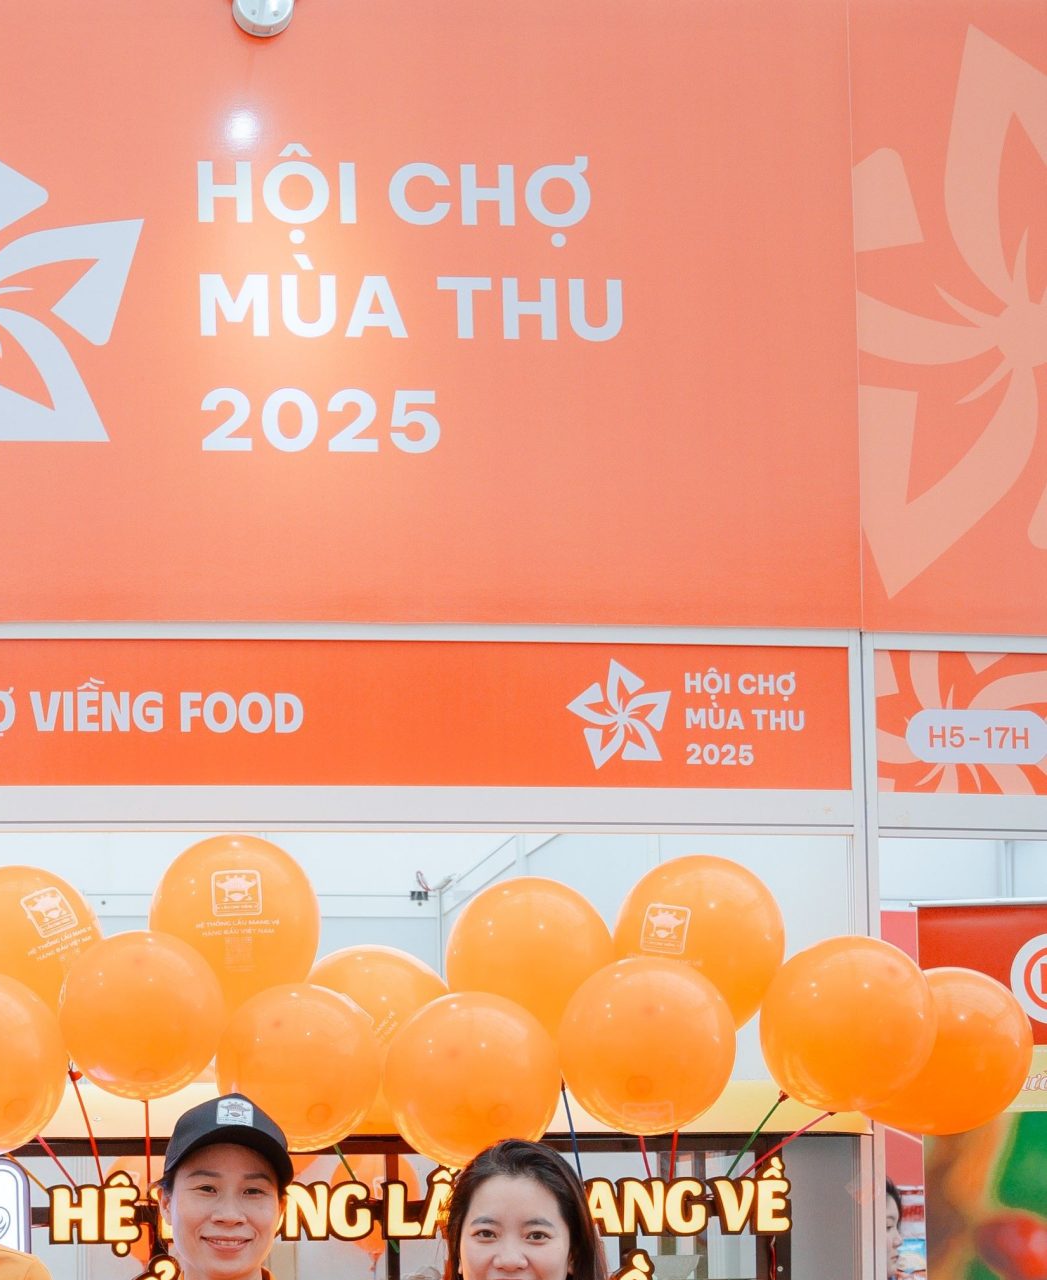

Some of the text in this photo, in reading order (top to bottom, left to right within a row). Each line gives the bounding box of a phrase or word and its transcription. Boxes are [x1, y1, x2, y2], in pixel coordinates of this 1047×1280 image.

[197, 143, 591, 247] HỘI CHỢ
[199, 253, 623, 341] MÙA THU
[201, 387, 441, 453] 2025
[31, 677, 165, 733] VIỀNG
[180, 691, 305, 733] FOOD
[685, 667, 796, 702] HỘI CHỢ
[685, 702, 805, 731] MÙA THU
[929, 725, 1029, 750] H5-17H
[686, 743, 754, 766] 2025
[51, 1172, 141, 1256] HỆ
[588, 1179, 707, 1234] ANG
[714, 1156, 791, 1233] VỀ
